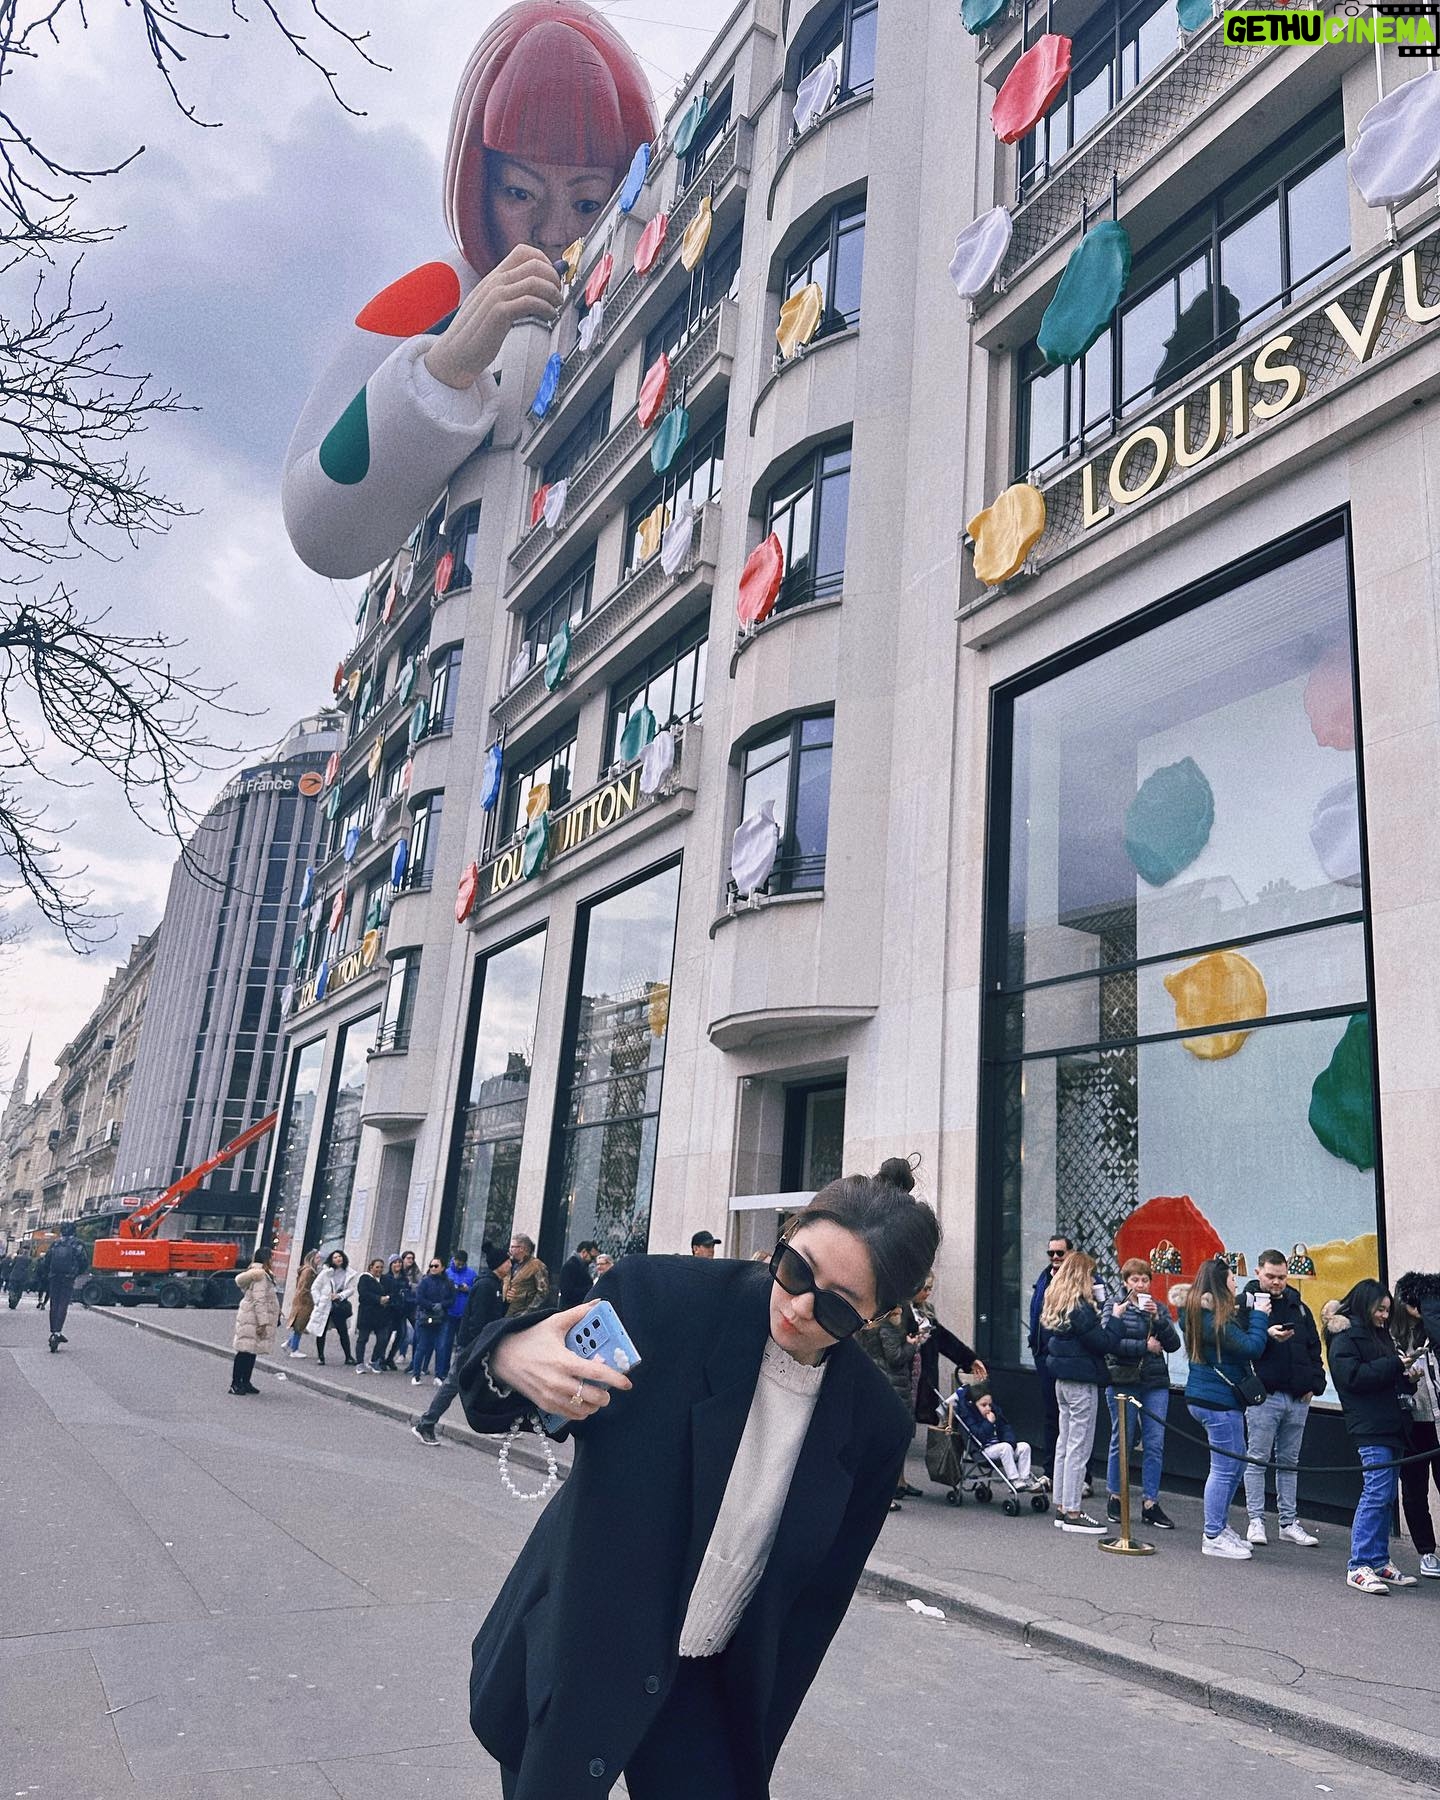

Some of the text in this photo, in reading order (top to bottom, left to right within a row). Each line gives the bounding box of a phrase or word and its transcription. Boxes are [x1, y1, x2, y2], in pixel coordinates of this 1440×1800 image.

[1082, 335, 1304, 529] LOUIS
[247, 779, 292, 793] France
[491, 844, 525, 895] LOU
